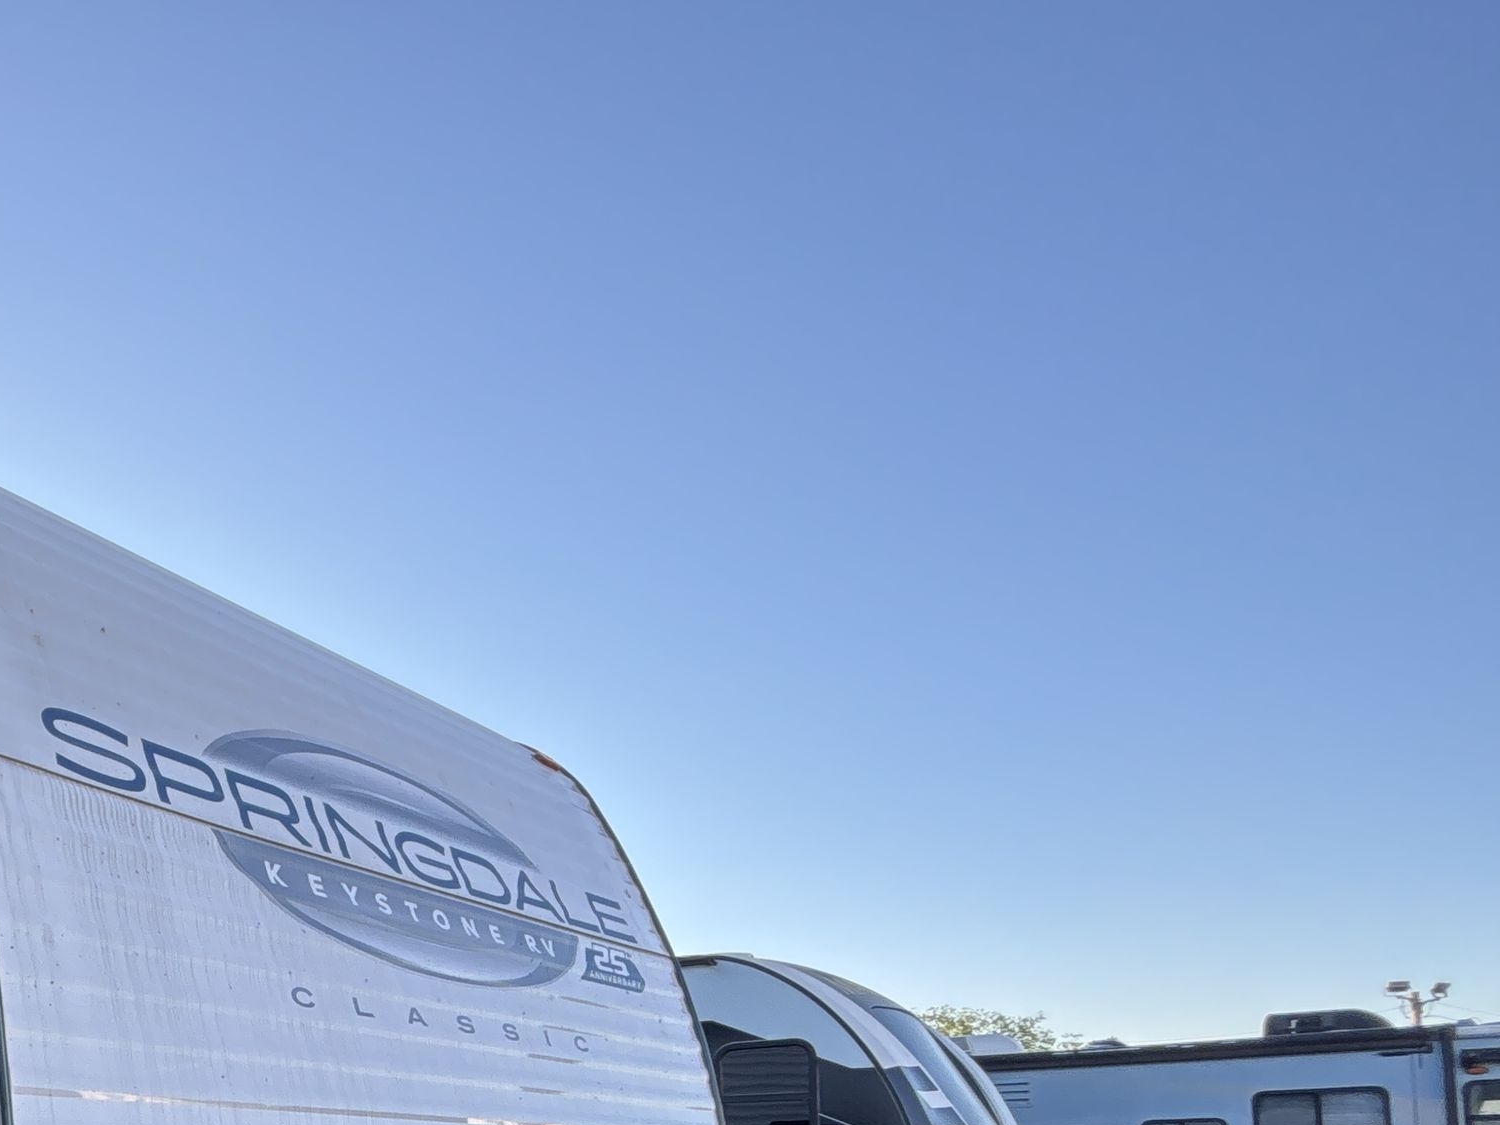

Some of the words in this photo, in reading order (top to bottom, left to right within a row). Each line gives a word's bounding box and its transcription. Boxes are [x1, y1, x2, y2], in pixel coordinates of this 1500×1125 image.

[41, 707, 637, 943] SPRINGDALE
[264, 860, 505, 945] KEYSTONE
[524, 933, 556, 958] RV
[290, 986, 589, 1053] CLASSIC
[588, 970, 644, 991] ANNIVERSARY
